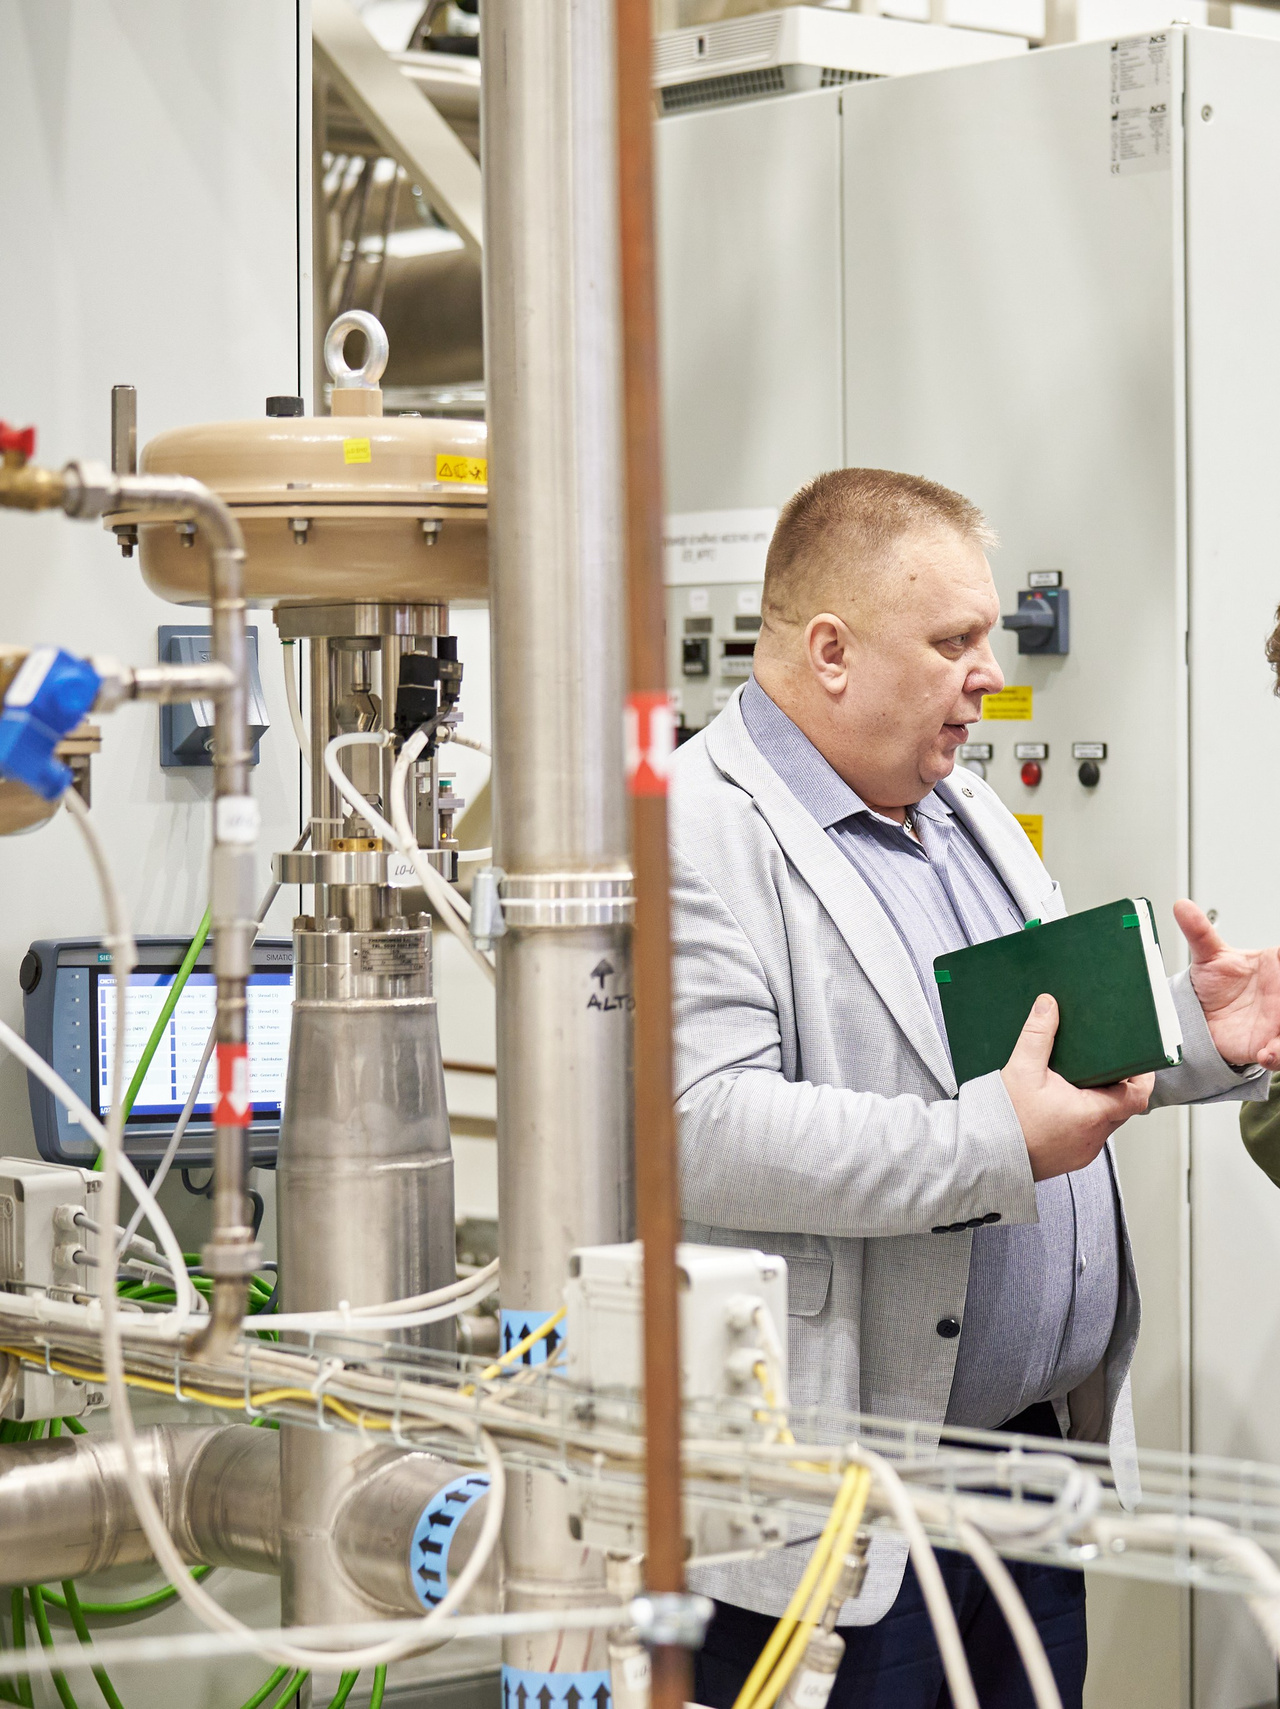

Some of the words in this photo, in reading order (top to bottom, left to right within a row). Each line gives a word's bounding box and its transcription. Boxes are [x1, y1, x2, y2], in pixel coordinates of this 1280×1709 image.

[1150, 35, 1166, 44] ACS
[1150, 104, 1166, 113] ACS
[266, 953, 293, 961] SIMATIC
